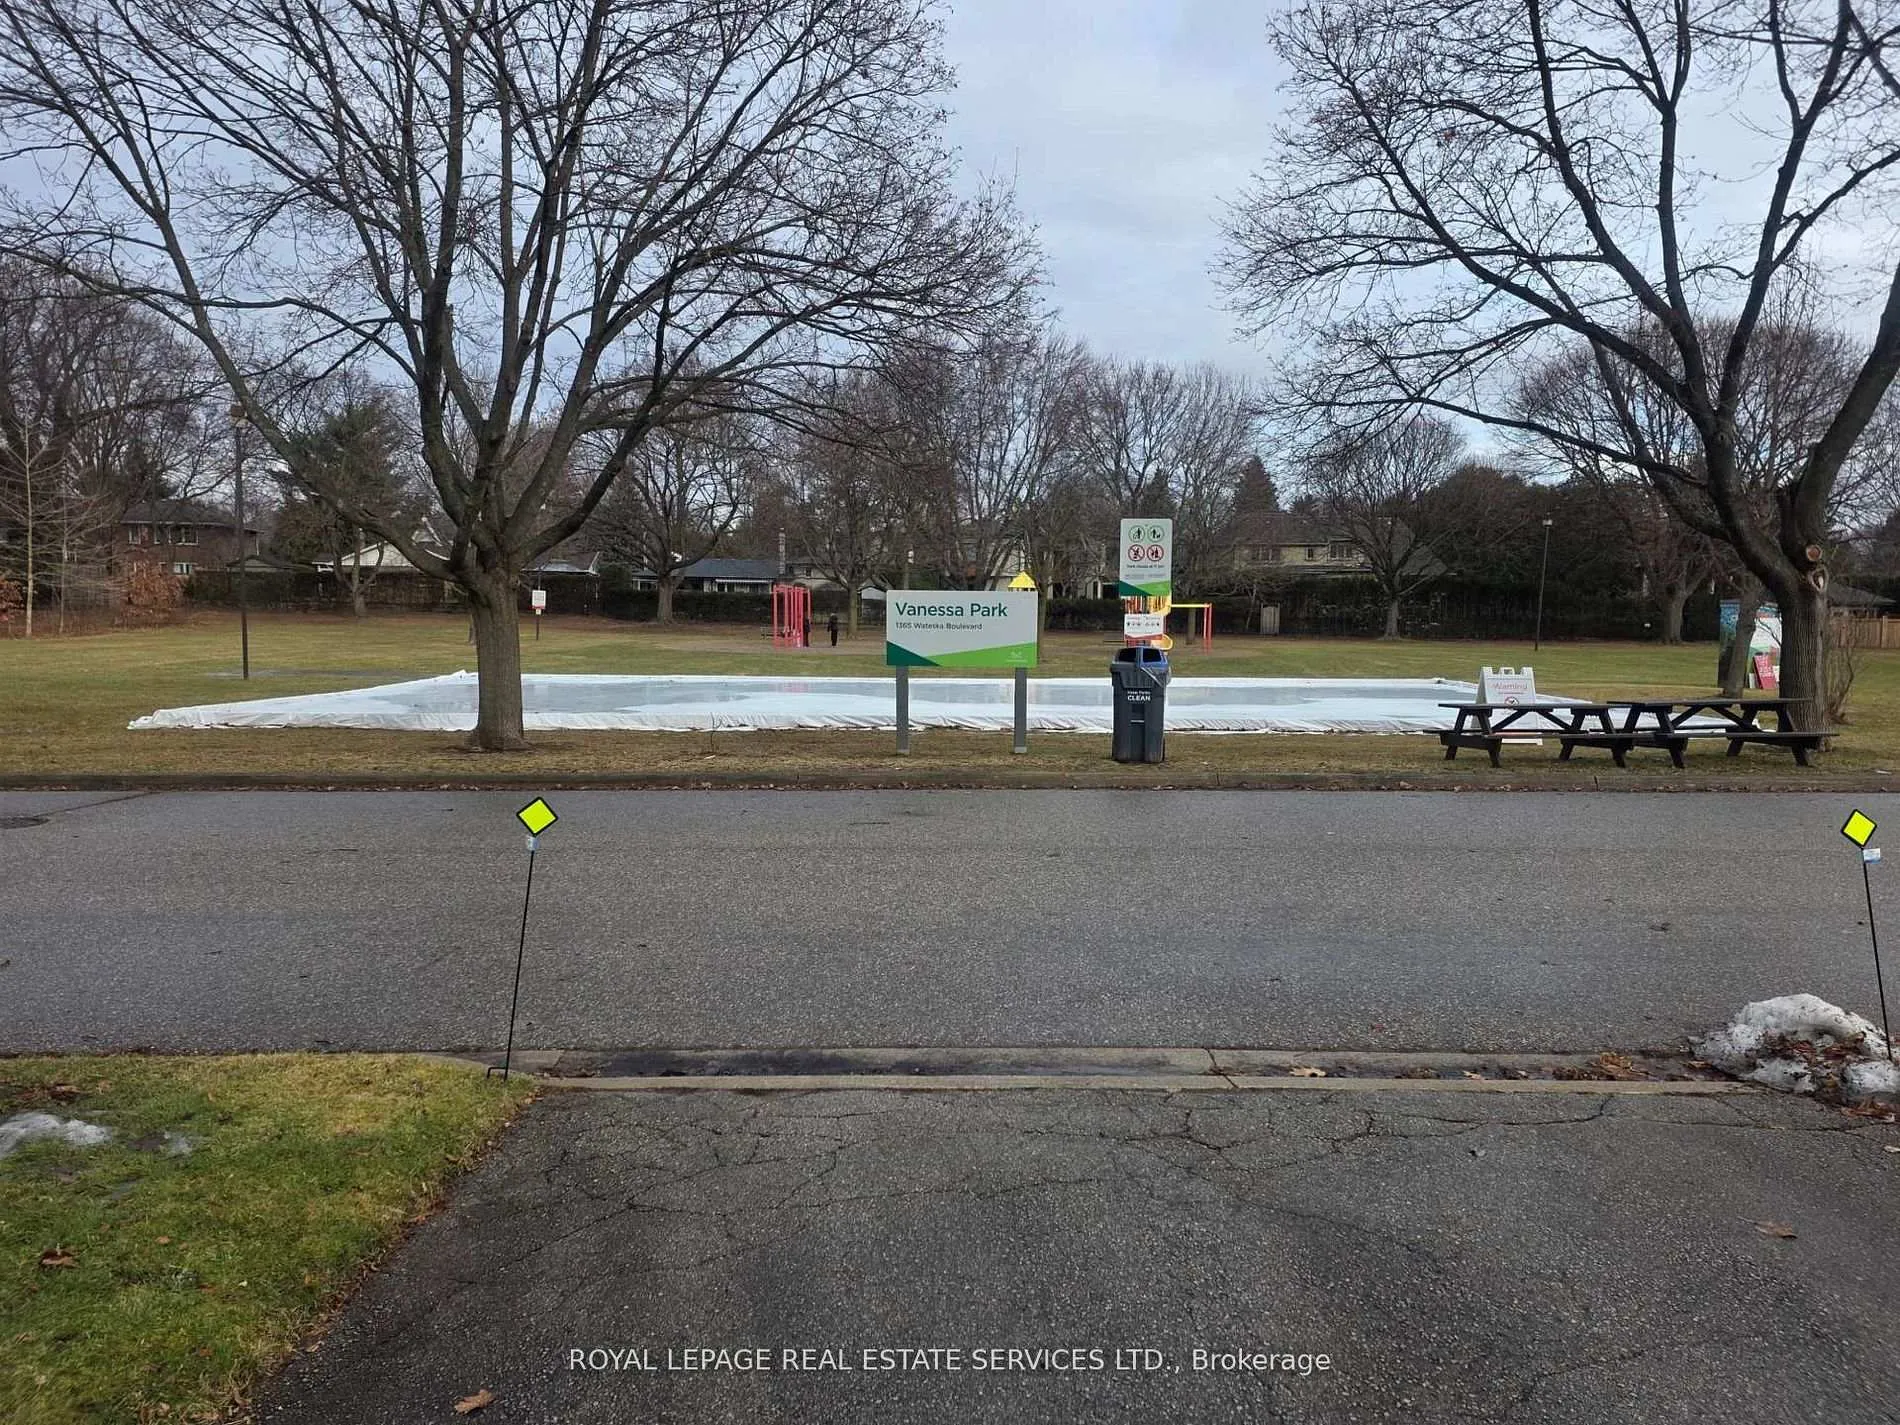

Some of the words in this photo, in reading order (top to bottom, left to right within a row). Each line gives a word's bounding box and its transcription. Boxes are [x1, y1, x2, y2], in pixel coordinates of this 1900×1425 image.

[895, 602, 964, 617] Vanessa
[970, 602, 1008, 617] Park
[895, 622, 912, 630] 1365
[946, 622, 983, 631] Boulevard
